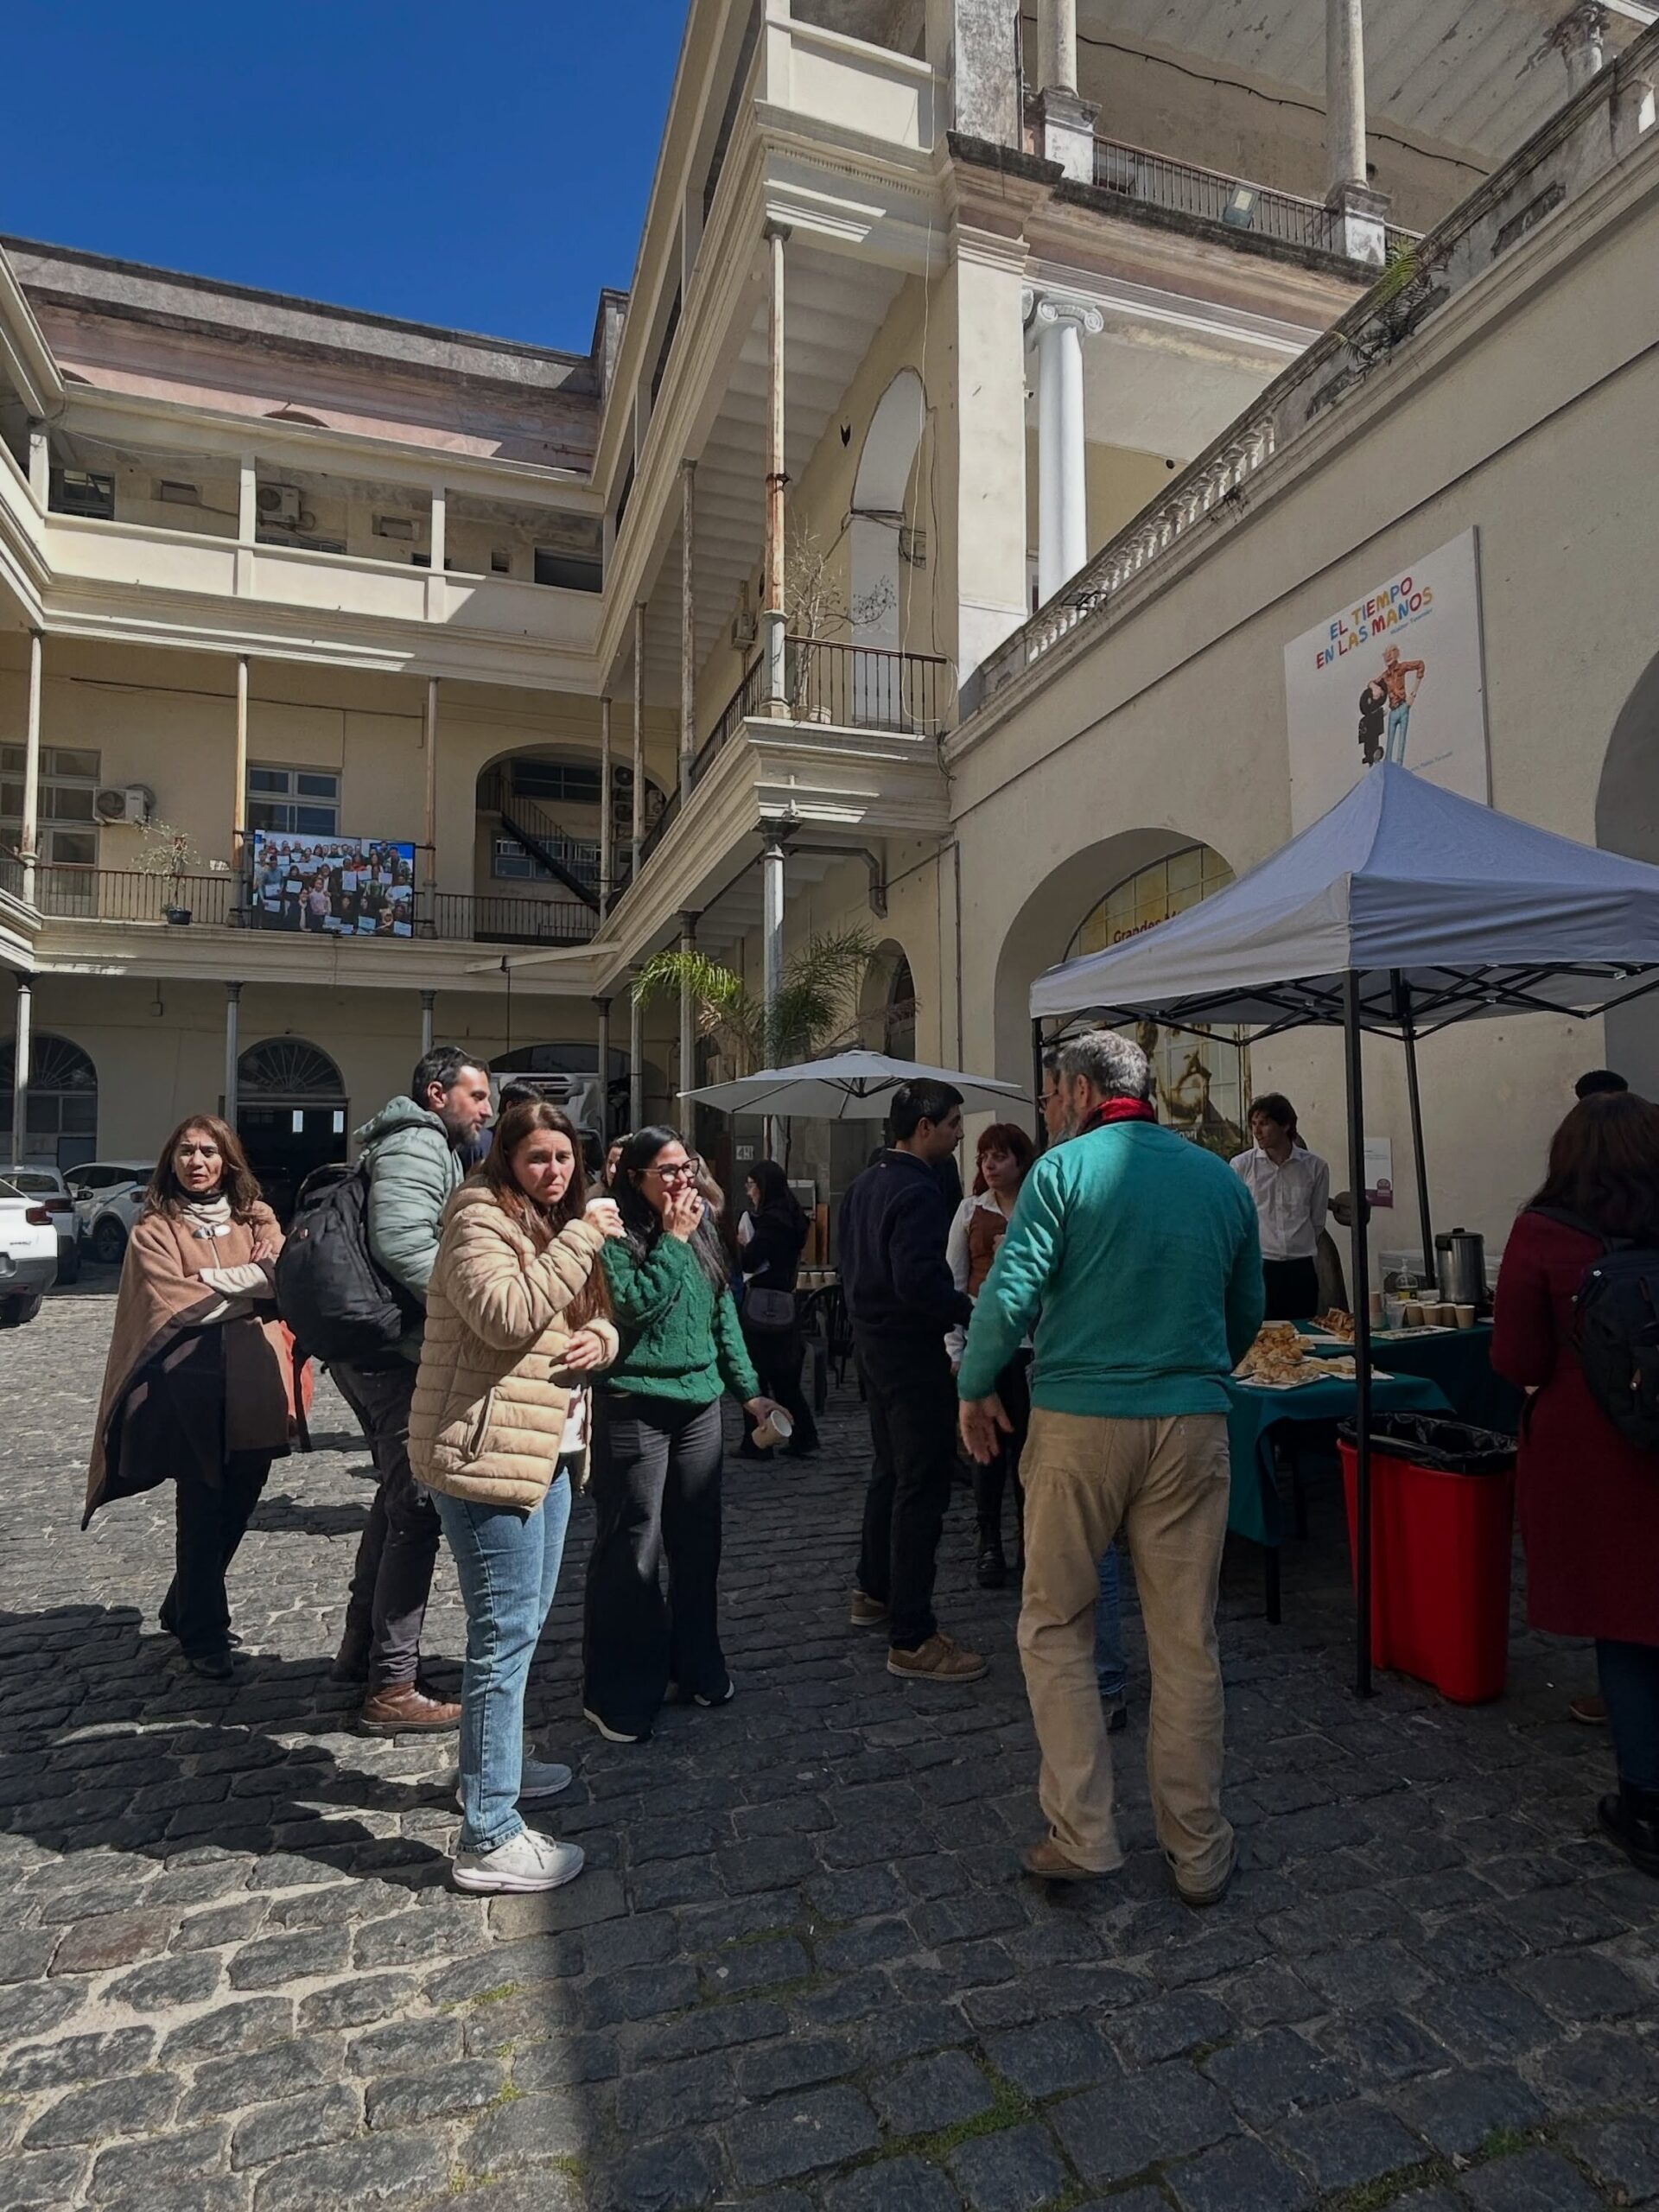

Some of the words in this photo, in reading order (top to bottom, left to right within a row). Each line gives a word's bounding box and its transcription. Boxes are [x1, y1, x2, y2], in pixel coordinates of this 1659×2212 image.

[1316, 645, 1334, 669] EN
[1338, 625, 1368, 656] LAS
[1371, 586, 1433, 636] MANOS
[1329, 619, 1348, 641] EL
[1351, 576, 1413, 625] TIEMPO
